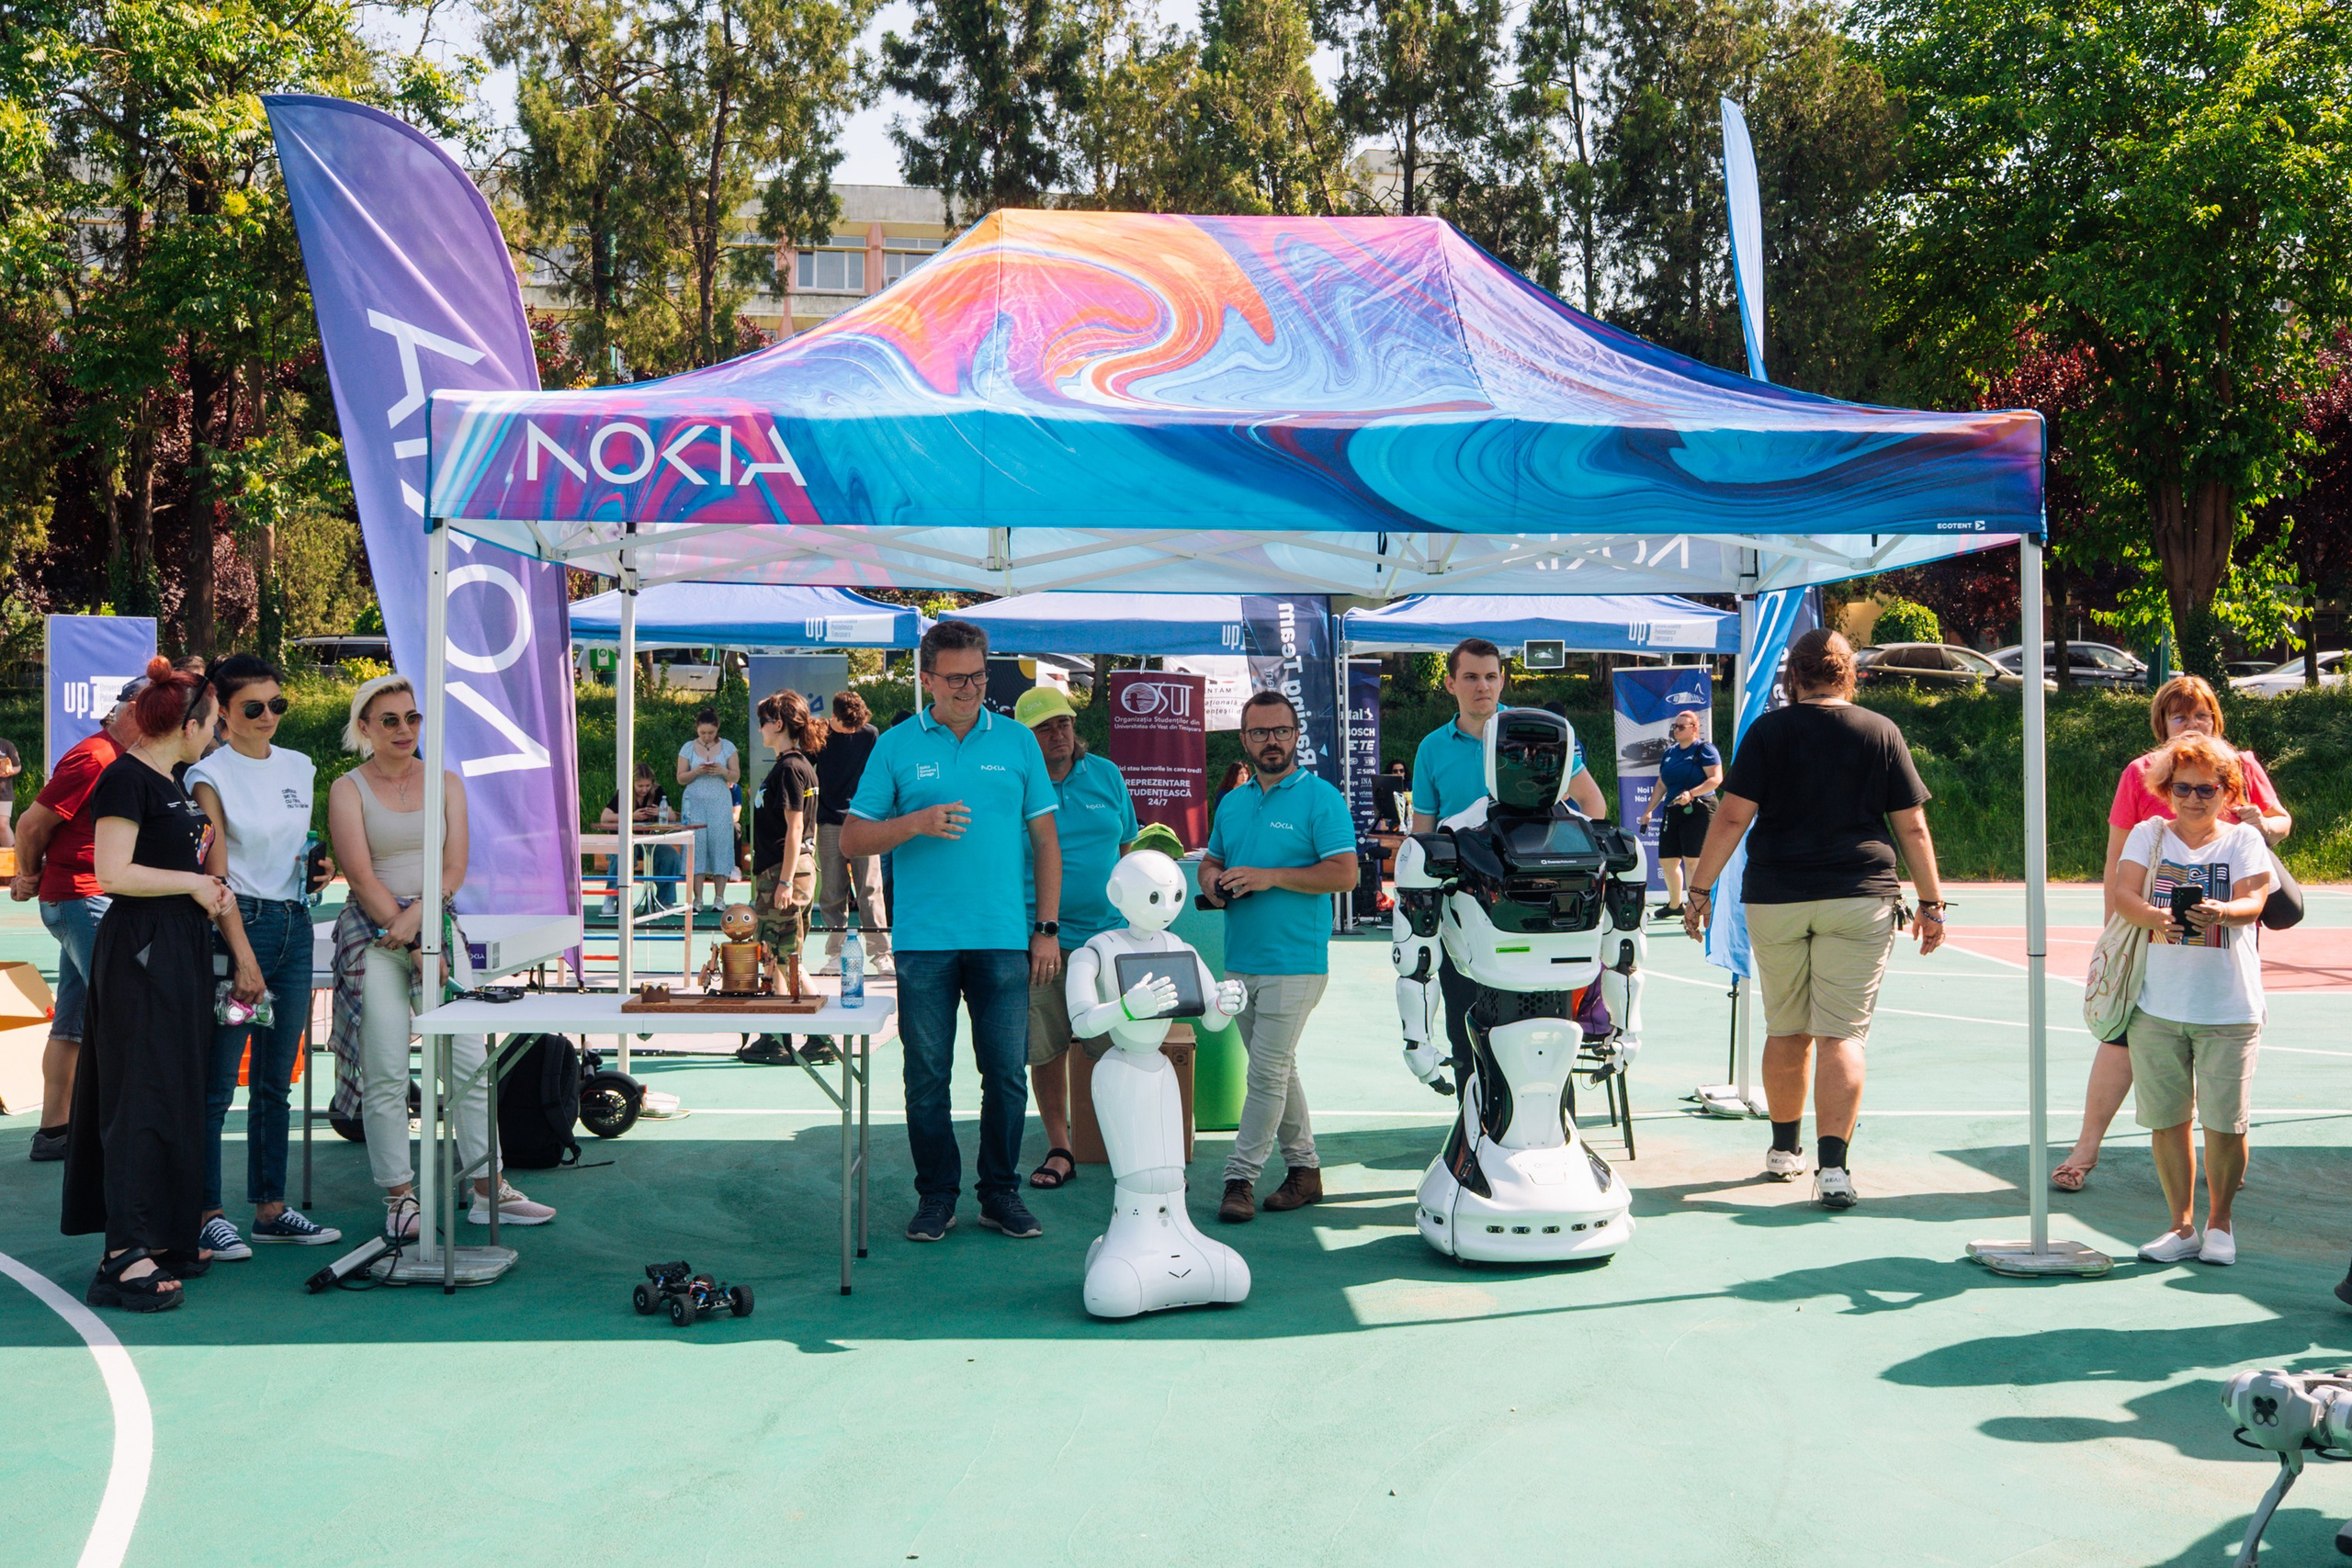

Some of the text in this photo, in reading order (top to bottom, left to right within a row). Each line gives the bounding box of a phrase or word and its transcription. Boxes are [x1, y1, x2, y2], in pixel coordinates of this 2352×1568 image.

[526, 418, 808, 487] NOKIA
[1121, 682, 1194, 716] OSUT
[1114, 716, 1152, 724] Organizația
[1154, 716, 1189, 725] Studenților
[1125, 778, 1191, 787] REPREZENTARE
[1127, 788, 1192, 798] TUDENȚEASCĂ
[1270, 821, 1294, 830] NOKIA
